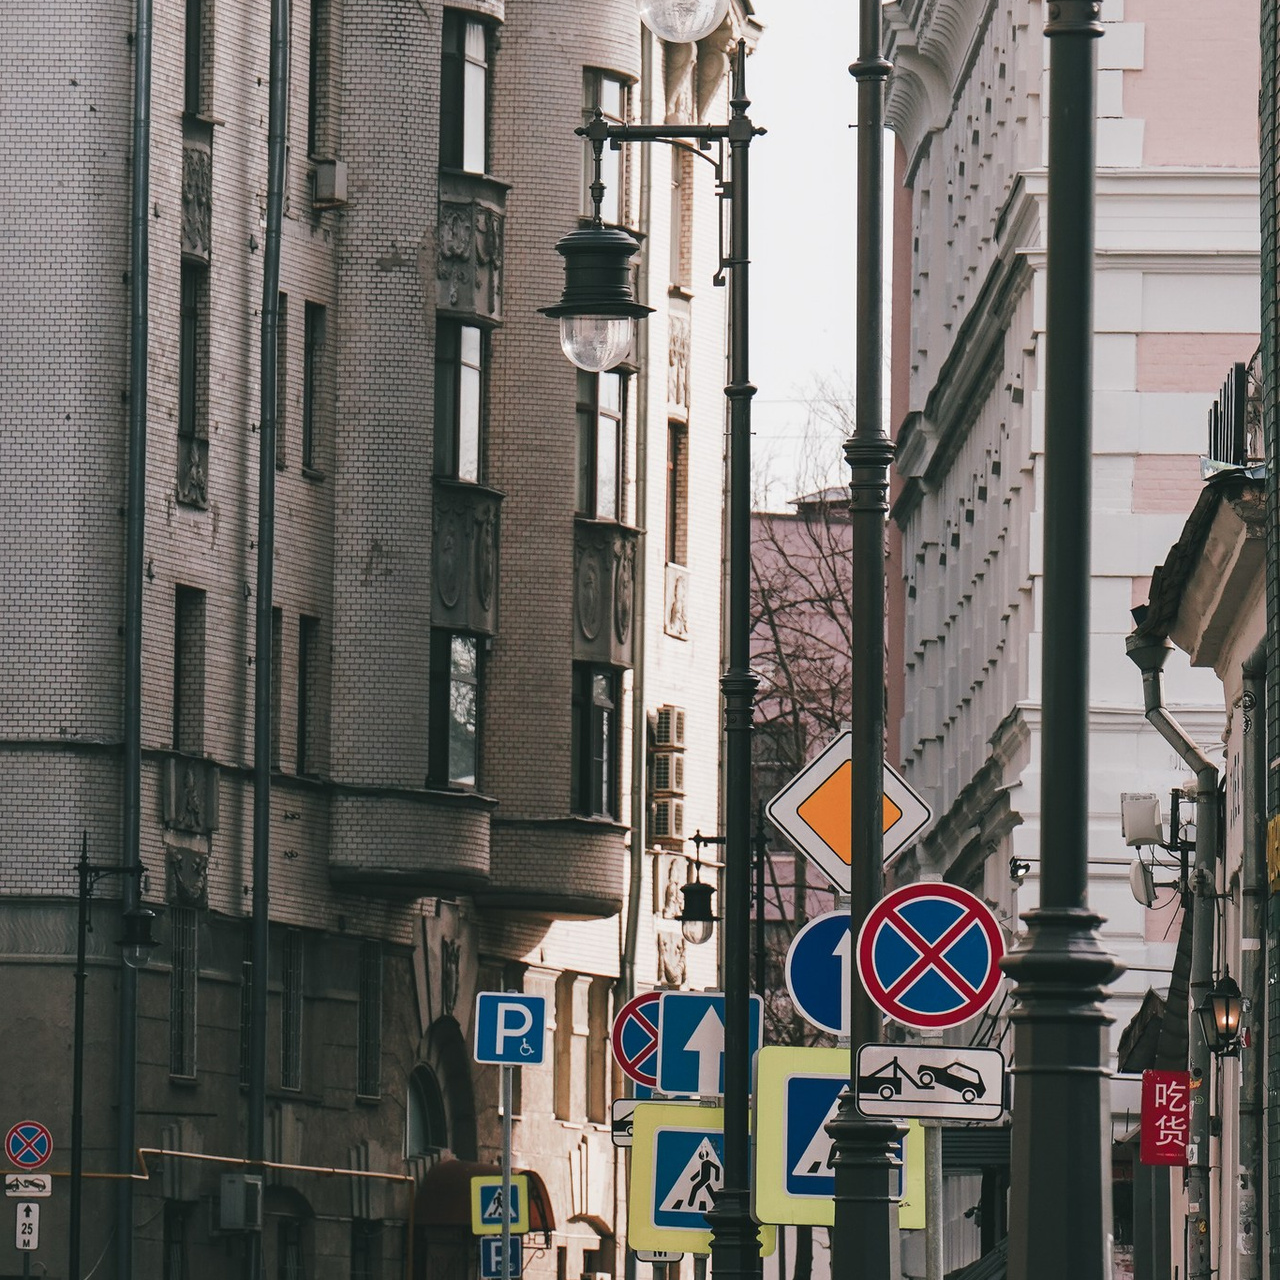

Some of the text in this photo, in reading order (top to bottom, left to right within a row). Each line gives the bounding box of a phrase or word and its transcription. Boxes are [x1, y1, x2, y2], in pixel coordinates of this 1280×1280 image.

[496, 1003, 533, 1055] P
[1155, 1081, 1187, 1147] 吃货
[21, 1223, 33, 1235] 25
